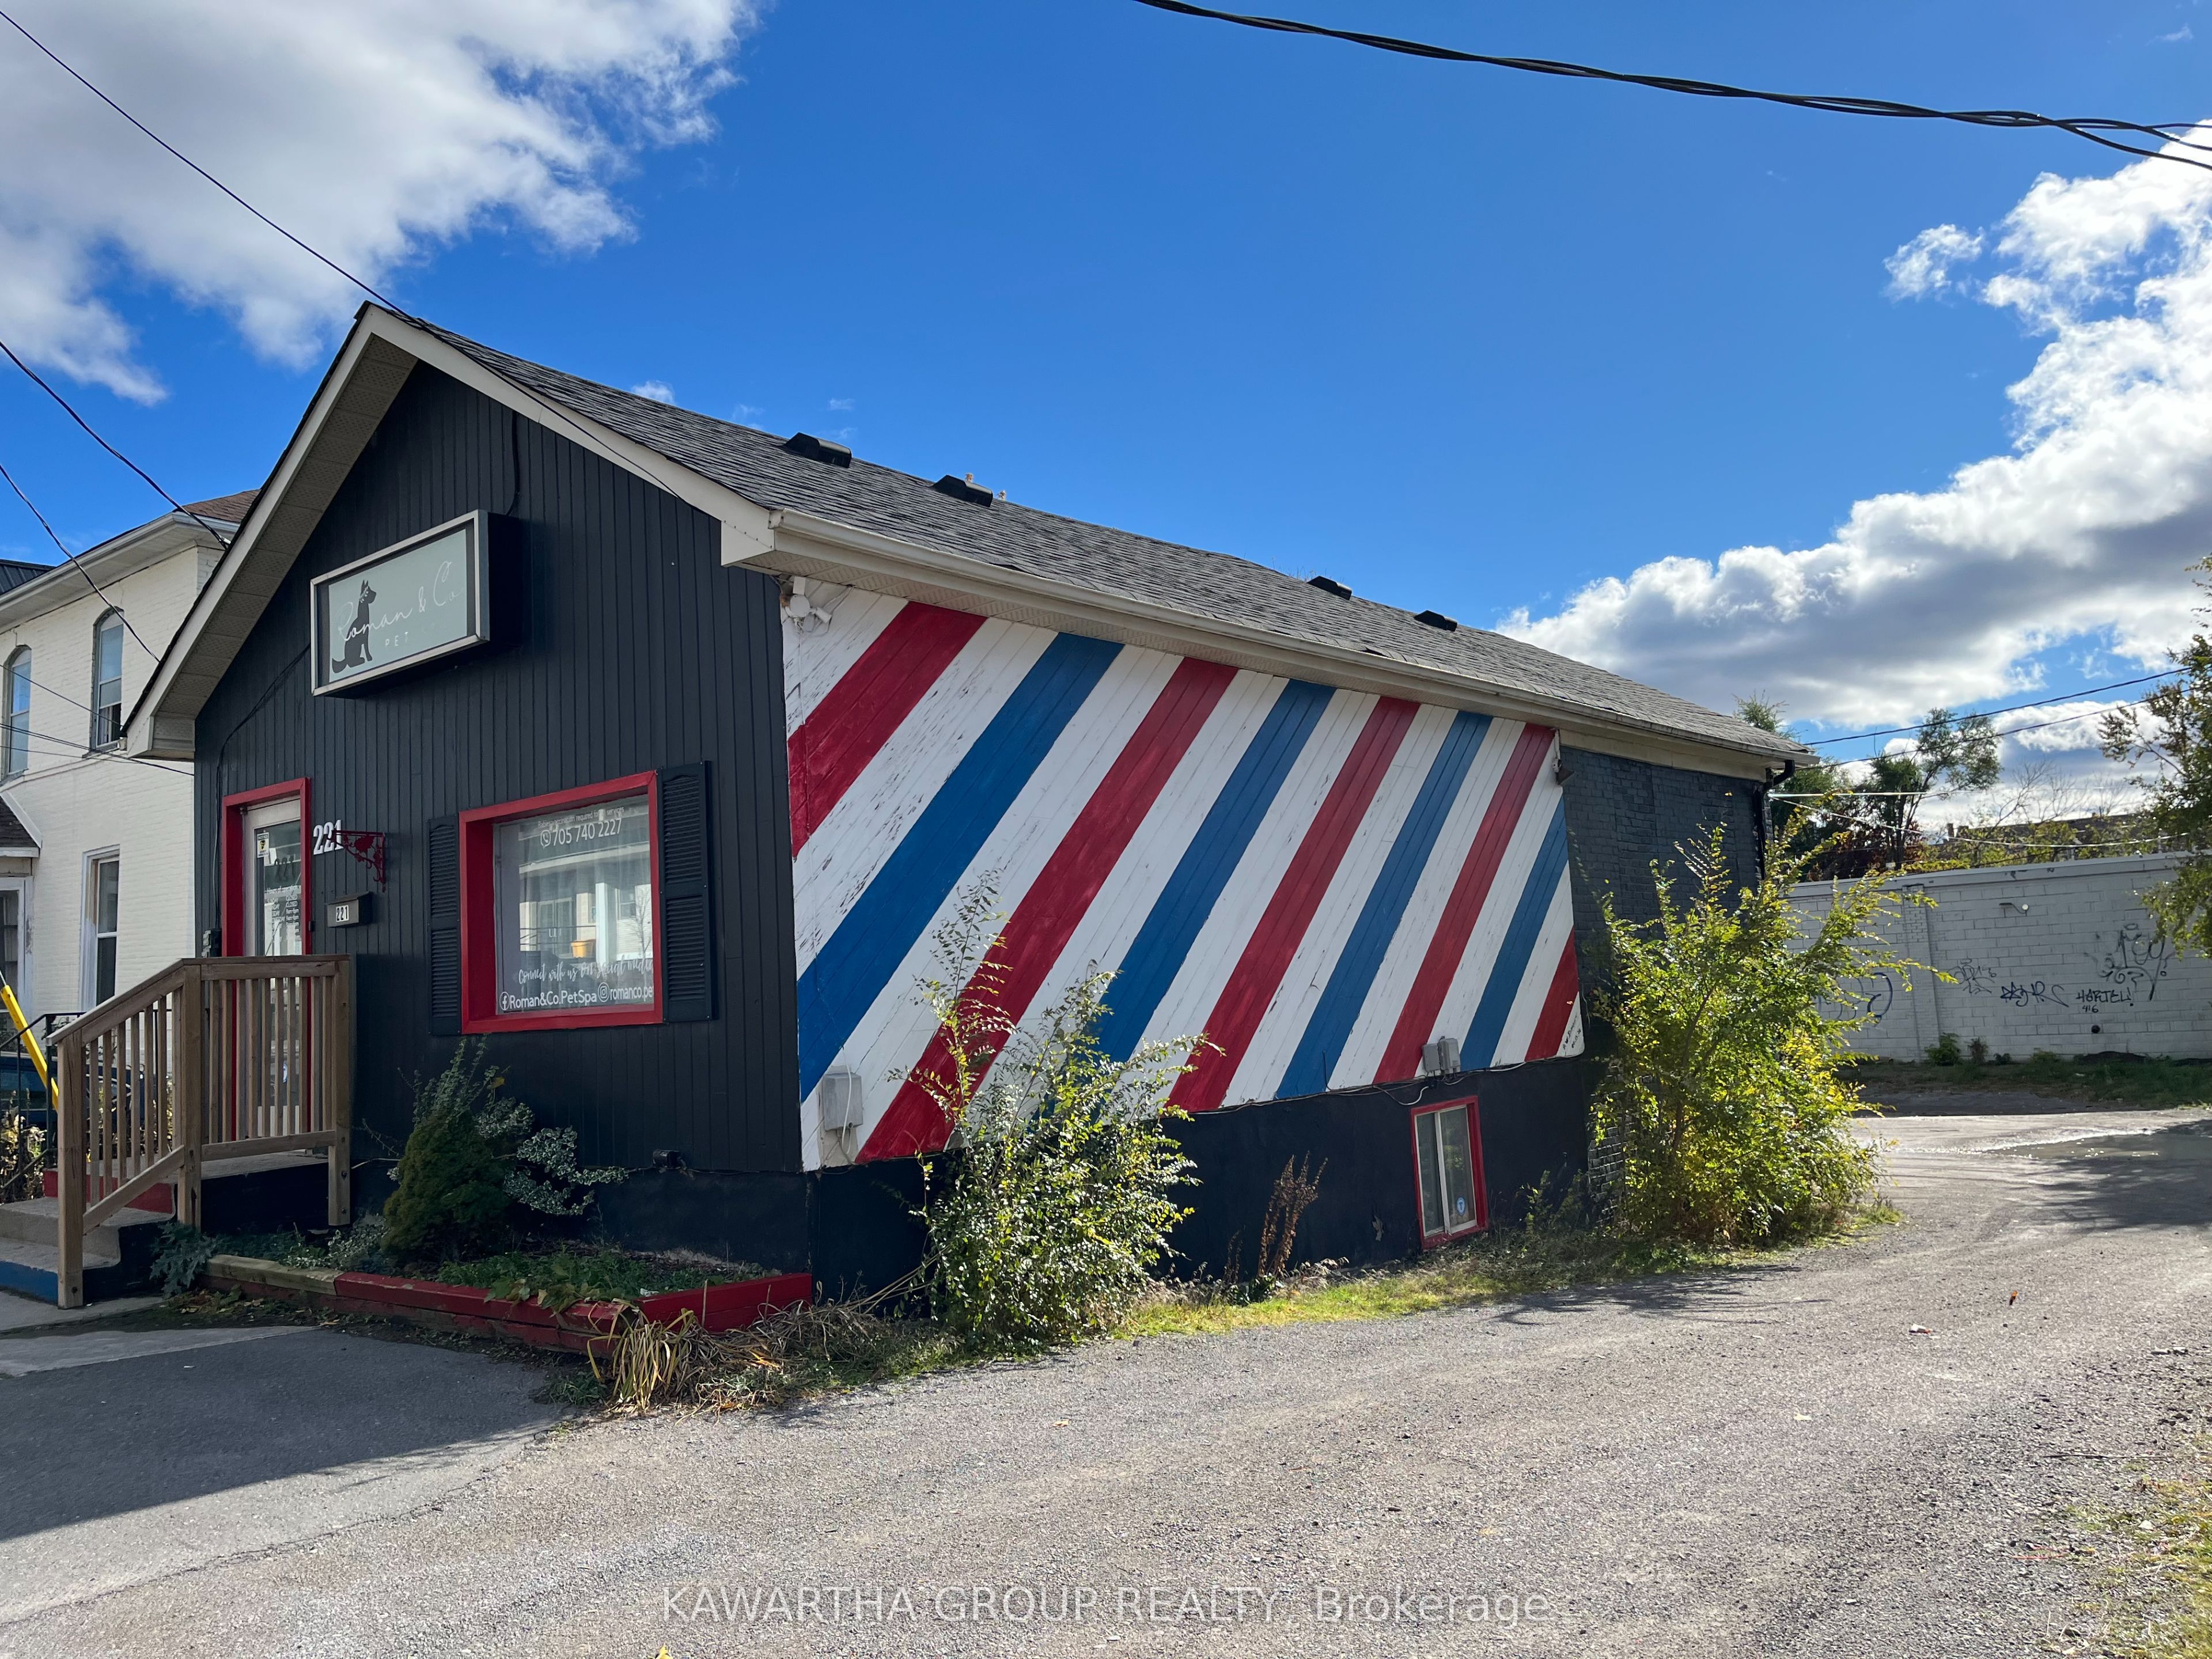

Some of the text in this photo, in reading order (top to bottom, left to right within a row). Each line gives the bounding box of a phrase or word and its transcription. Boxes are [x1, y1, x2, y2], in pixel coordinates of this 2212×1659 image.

[338, 601, 412, 641] Roman
[419, 586, 426, 612] &
[385, 631, 409, 647] PET
[313, 819, 344, 855] 221
[553, 817, 622, 846] 705 740 2227
[336, 906, 349, 921] 221
[548, 961, 565, 982] with
[610, 986, 653, 1002] romanco.pe
[2082, 1005, 2099, 1013] 416
